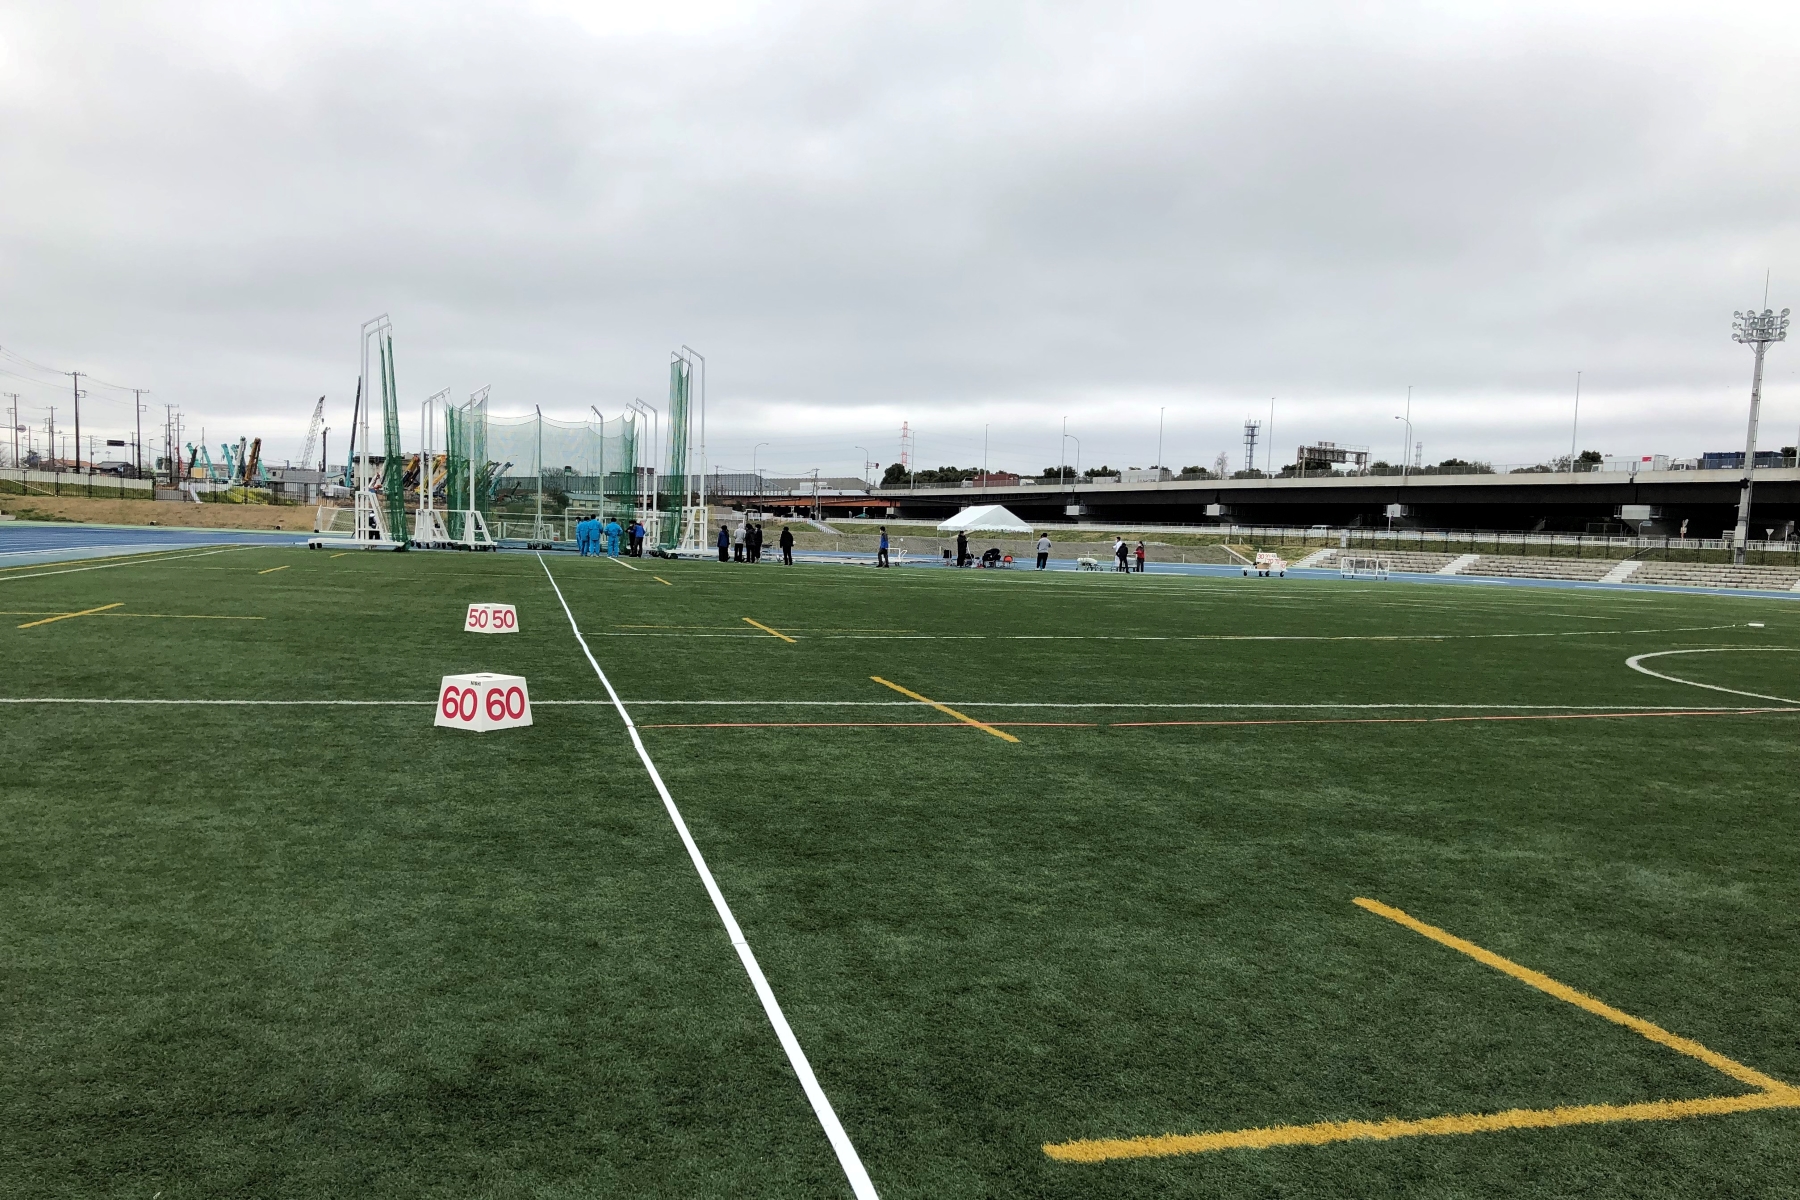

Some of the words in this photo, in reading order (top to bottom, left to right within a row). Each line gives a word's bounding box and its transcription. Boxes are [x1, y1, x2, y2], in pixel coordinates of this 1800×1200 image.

[469, 608, 488, 628] 50
[492, 609, 515, 629] 50
[442, 685, 478, 722] 60
[485, 685, 525, 722] 60
